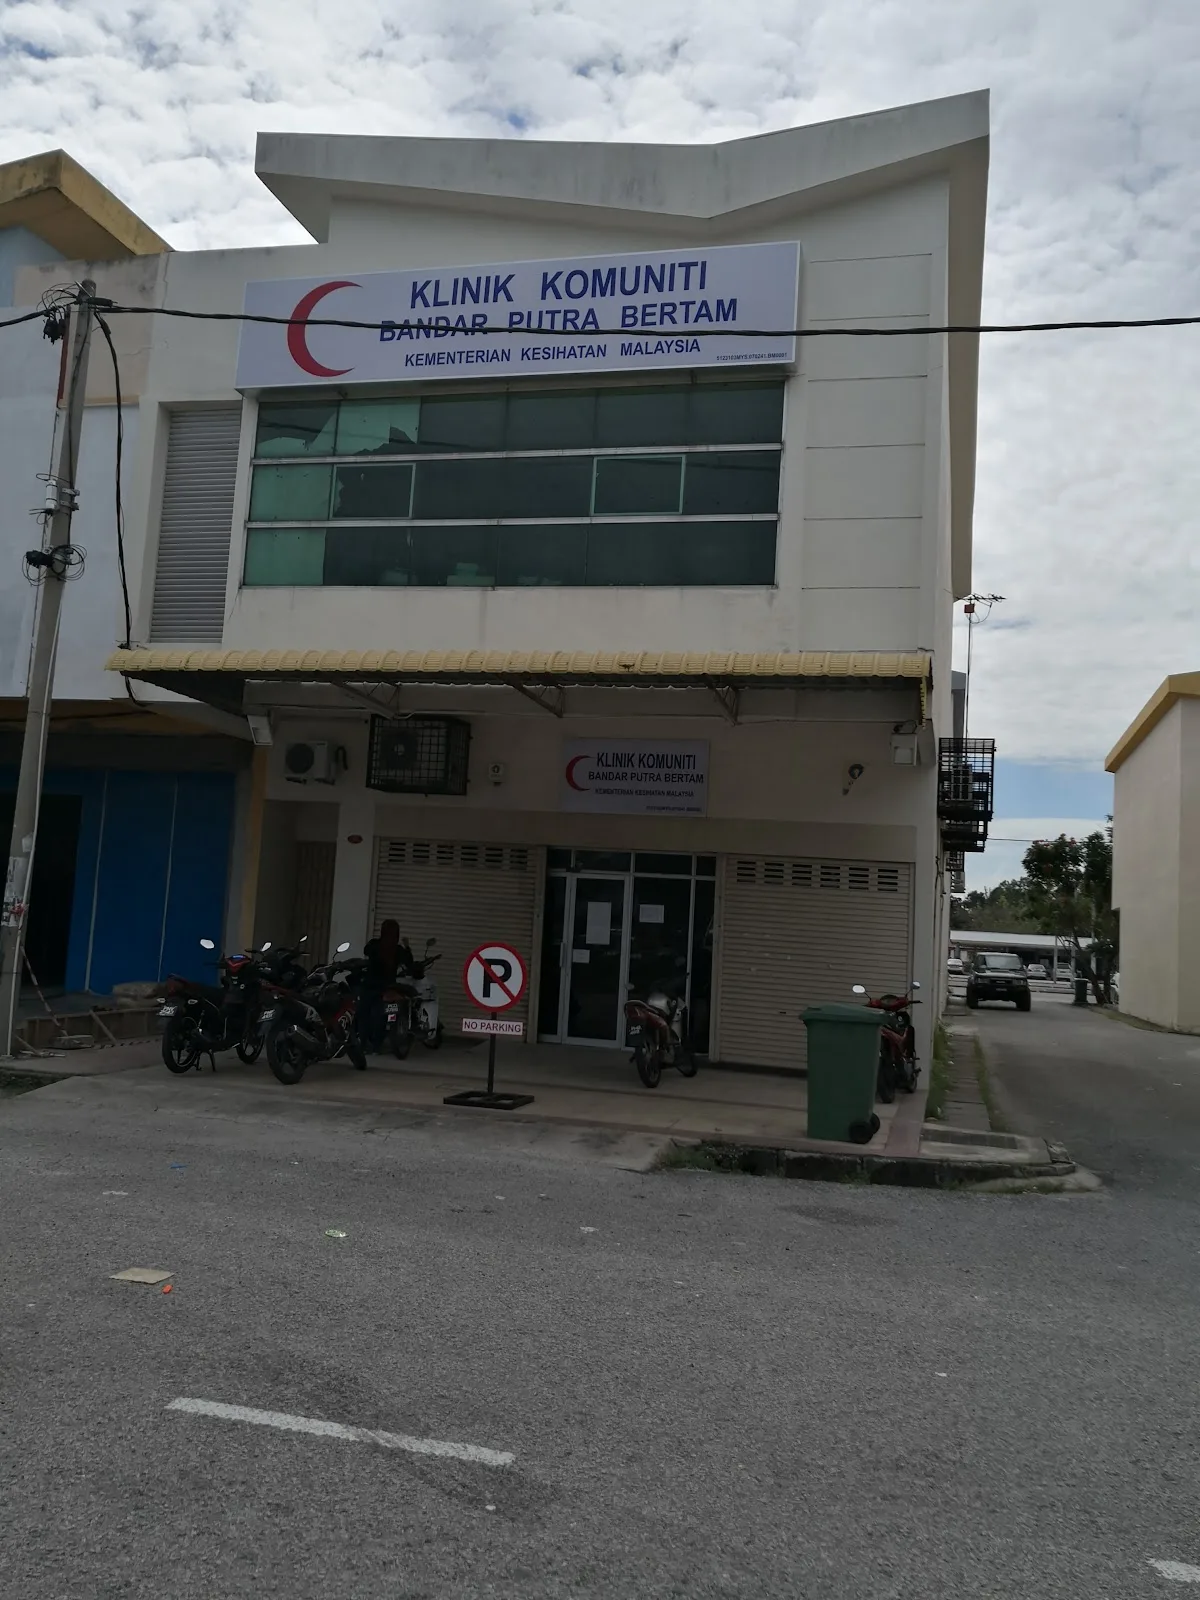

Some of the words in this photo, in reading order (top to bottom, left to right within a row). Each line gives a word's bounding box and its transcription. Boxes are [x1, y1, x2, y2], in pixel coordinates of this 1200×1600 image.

[410, 273, 516, 309] KLINIK
[540, 260, 707, 301] KOMUNITI
[379, 313, 488, 342] BANDAR
[508, 307, 600, 333] PUTRA
[620, 298, 737, 328] BERTAM
[405, 348, 511, 367] KEMENTERIAN
[520, 344, 607, 362] KESIHATAN
[620, 338, 701, 357] MALAYSIA
[596, 752, 636, 768] KLINIK
[638, 753, 696, 770] KOMUNITI
[588, 771, 628, 781] BANDAR
[630, 772, 662, 783] PUTRA
[664, 773, 704, 784] BERTAM
[666, 790, 694, 798] MALAYSIA
[464, 1021, 478, 1030] NO
[480, 1022, 521, 1033] PARKING
